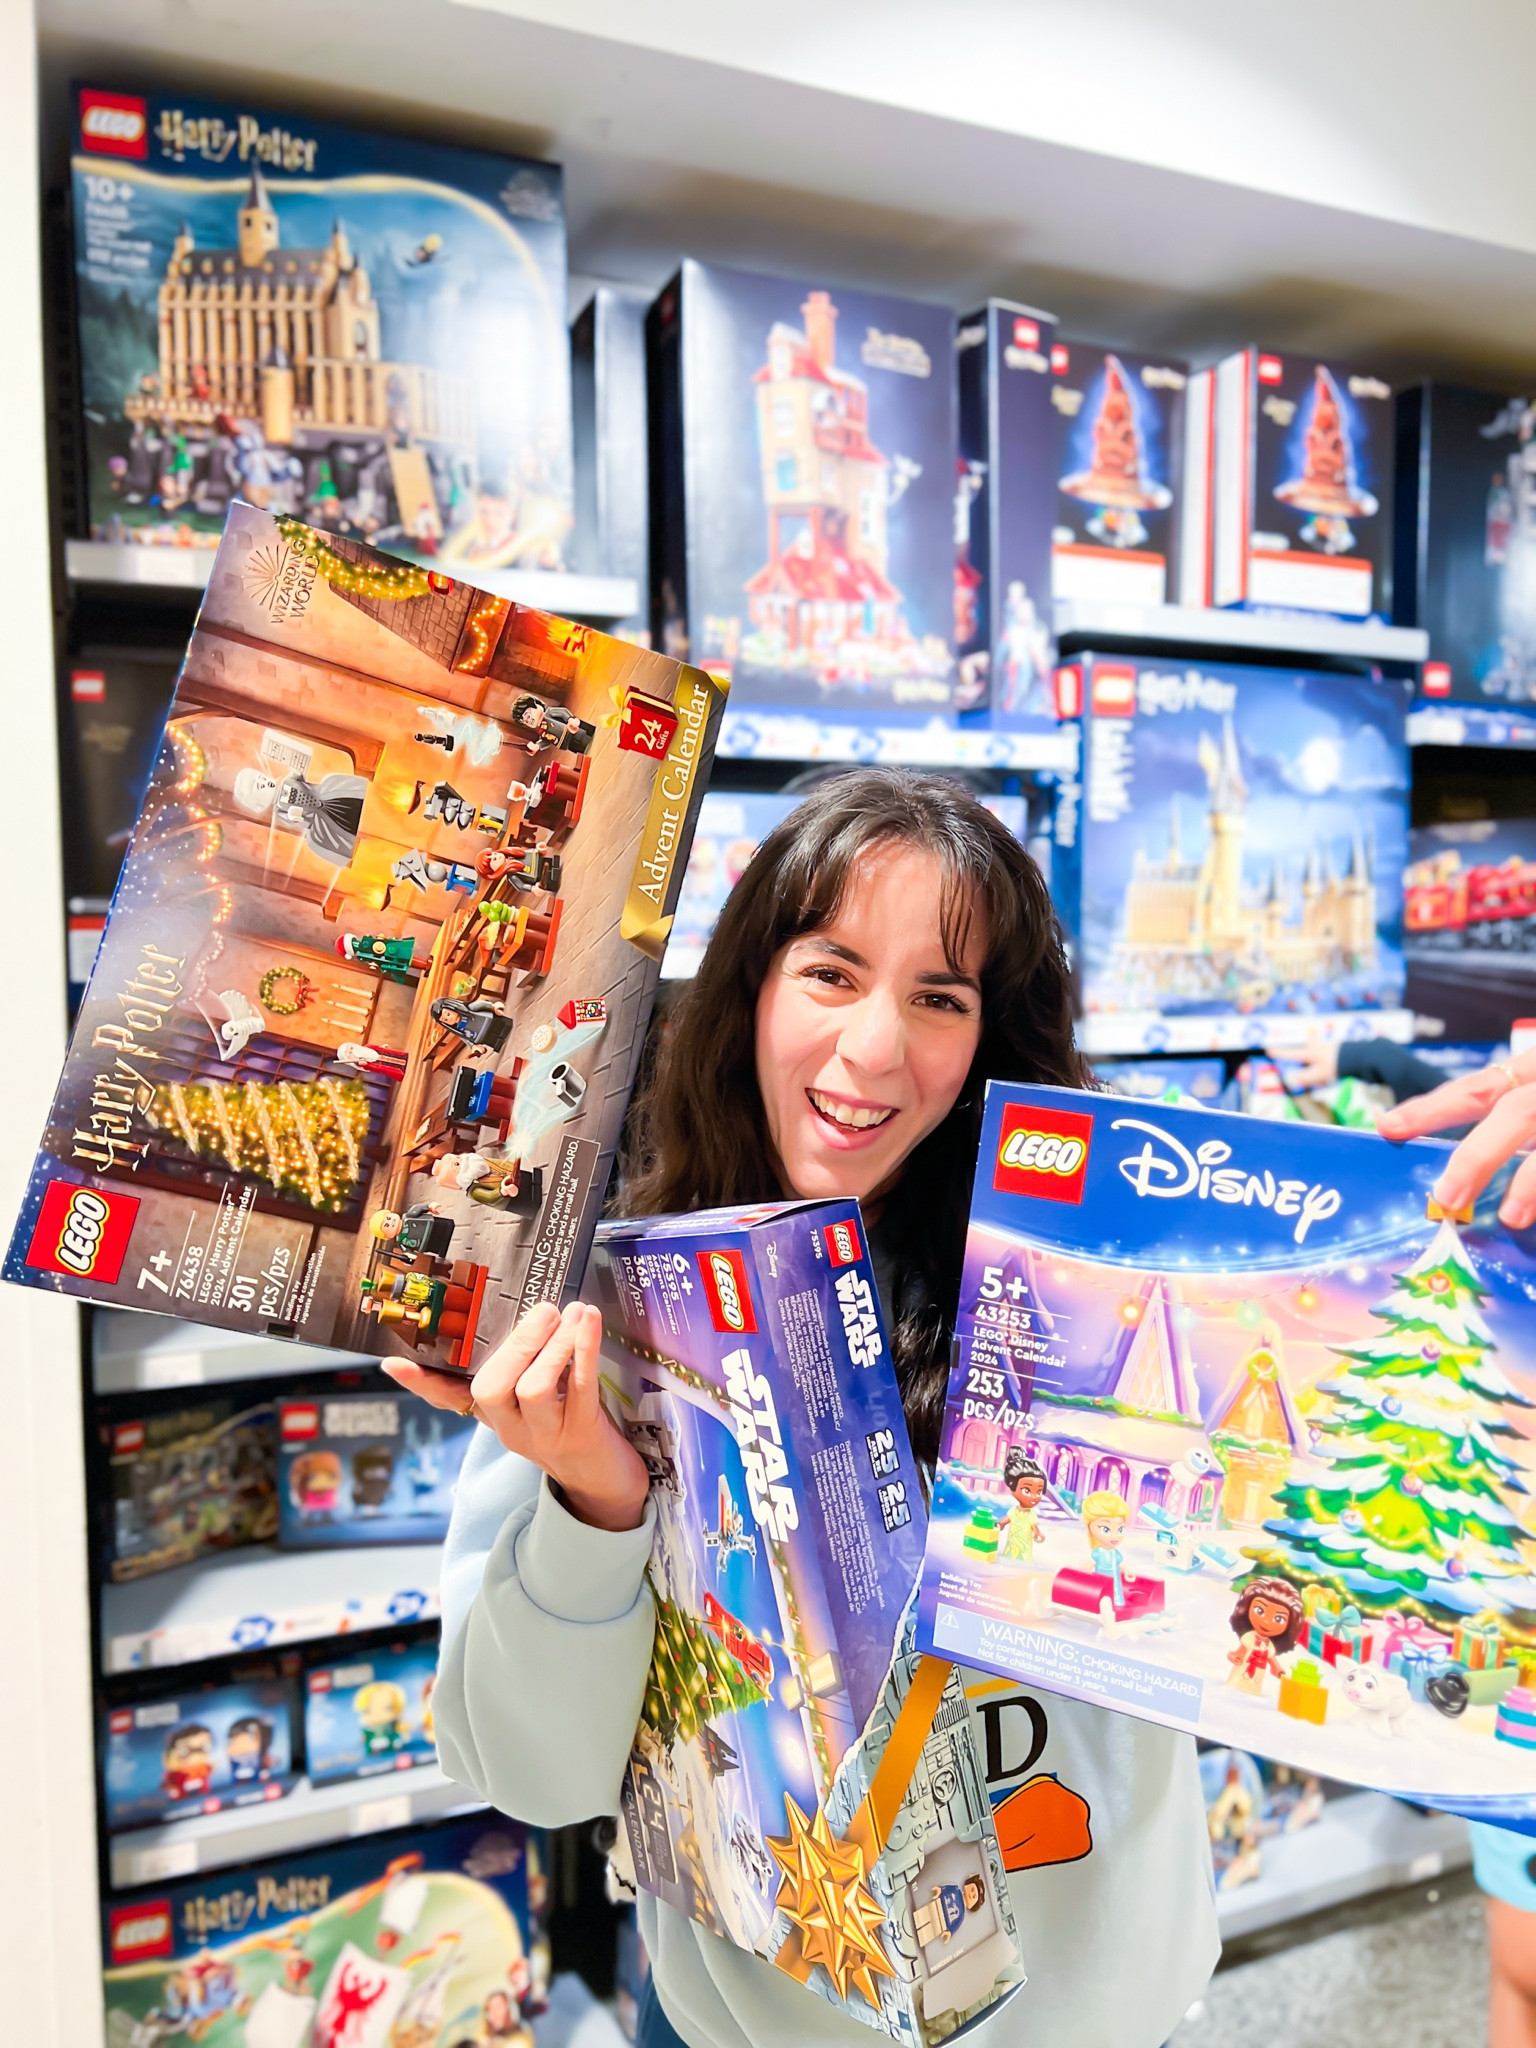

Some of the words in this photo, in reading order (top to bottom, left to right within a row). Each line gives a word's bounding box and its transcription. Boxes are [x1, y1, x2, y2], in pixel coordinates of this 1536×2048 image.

[86, 108, 143, 140] LEGO
[154, 109, 238, 162] Harry
[237, 114, 318, 172] Potter
[271, 537, 307, 623] WIZARDING
[290, 553, 322, 617] WORLD
[635, 719, 662, 750] 24
[655, 730, 670, 750] Gifts
[638, 808, 680, 906] Advent
[661, 683, 710, 801] Calendar
[90, 943, 187, 1062] Potter
[72, 1053, 159, 1172] Harry
[1004, 1133, 1082, 1171] LEGO
[563, 1193, 574, 1214] small
[567, 1176, 579, 1193] ball.
[60, 1194, 105, 1270] LEGO
[210, 1278, 226, 1306] 2024
[219, 1237, 238, 1276] Advent
[230, 1186, 252, 1234] Calendar
[516, 1238, 553, 1327] WARNING:
[546, 1186, 566, 1237] CHOKING
[559, 1140, 580, 1185] HAZARD.
[552, 1237, 563, 1257] parts
[557, 1220, 567, 1236] and
[810, 1229, 822, 1259] 75395
[835, 1227, 851, 1259] LEGO
[137, 1250, 172, 1293] 7+
[176, 1246, 203, 1299] 76438
[208, 1237, 226, 1267] Harry
[546, 1257, 557, 1278] small
[549, 1270, 564, 1301] children
[558, 1246, 570, 1269] under
[566, 1216, 579, 1239] years.
[633, 1255, 651, 1288] 368
[646, 1254, 656, 1279] 2024
[228, 1275, 258, 1312] 301
[248, 1247, 290, 1317] pcs/pzs
[292, 1304, 302, 1322] Jouet
[297, 1294, 304, 1303] de
[301, 1252, 316, 1293] construction
[539, 1279, 551, 1302] ntains
[621, 1257, 645, 1316] pcs/pzs
[651, 1254, 665, 1289] Advent
[662, 1292, 677, 1335] Calendar
[660, 1253, 680, 1301] 75395
[673, 1253, 693, 1296] 6+
[713, 1258, 741, 1325] LEGO
[979, 1266, 1028, 1299] 5+
[284, 1293, 297, 1320] Building
[292, 1280, 301, 1292] Toy
[299, 1298, 312, 1324] Juguete
[307, 1288, 314, 1297] de
[847, 1270, 882, 1366] STAR
[976, 1304, 1031, 1329] 43253
[970, 1351, 998, 1365] 2024
[971, 1338, 1012, 1356] Advent
[1014, 1348, 1067, 1368] Calendar
[1010, 1334, 1049, 1353] Disney
[966, 1368, 1005, 1398] 253
[963, 1398, 1036, 1434] pcs/pzs
[739, 1349, 799, 1543] STAR
[875, 1429, 899, 1473] 25
[886, 1481, 910, 1535] 25
[938, 1588, 964, 1601] Juguete
[939, 1581, 958, 1591] Jouet
[940, 1572, 968, 1586] Building
[969, 1579, 982, 1590] Toy
[977, 1647, 994, 1659] Not
[995, 1652, 1008, 1663] for
[1009, 1658, 1044, 1674] children
[1046, 1668, 1072, 1682] under
[1073, 1675, 1080, 1684] 3
[1081, 1679, 1107, 1693] years.
[979, 1637, 995, 1650] Toy
[996, 1644, 1033, 1660] contains
[1034, 1654, 1057, 1667] small
[1058, 1661, 1081, 1675] parts
[1083, 1669, 1100, 1680] and
[1110, 1676, 1133, 1690] small
[1135, 1682, 1154, 1696] ball.
[982, 1620, 1079, 1663] WARNING:
[1082, 1655, 1141, 1681] CHOKING
[1144, 1672, 1199, 1698] HAZARD.
[643, 1784, 665, 1834] 24
[624, 1792, 646, 1870] CALENDAR
[181, 1891, 257, 1943] Harry
[256, 1876, 332, 1920] Potter
